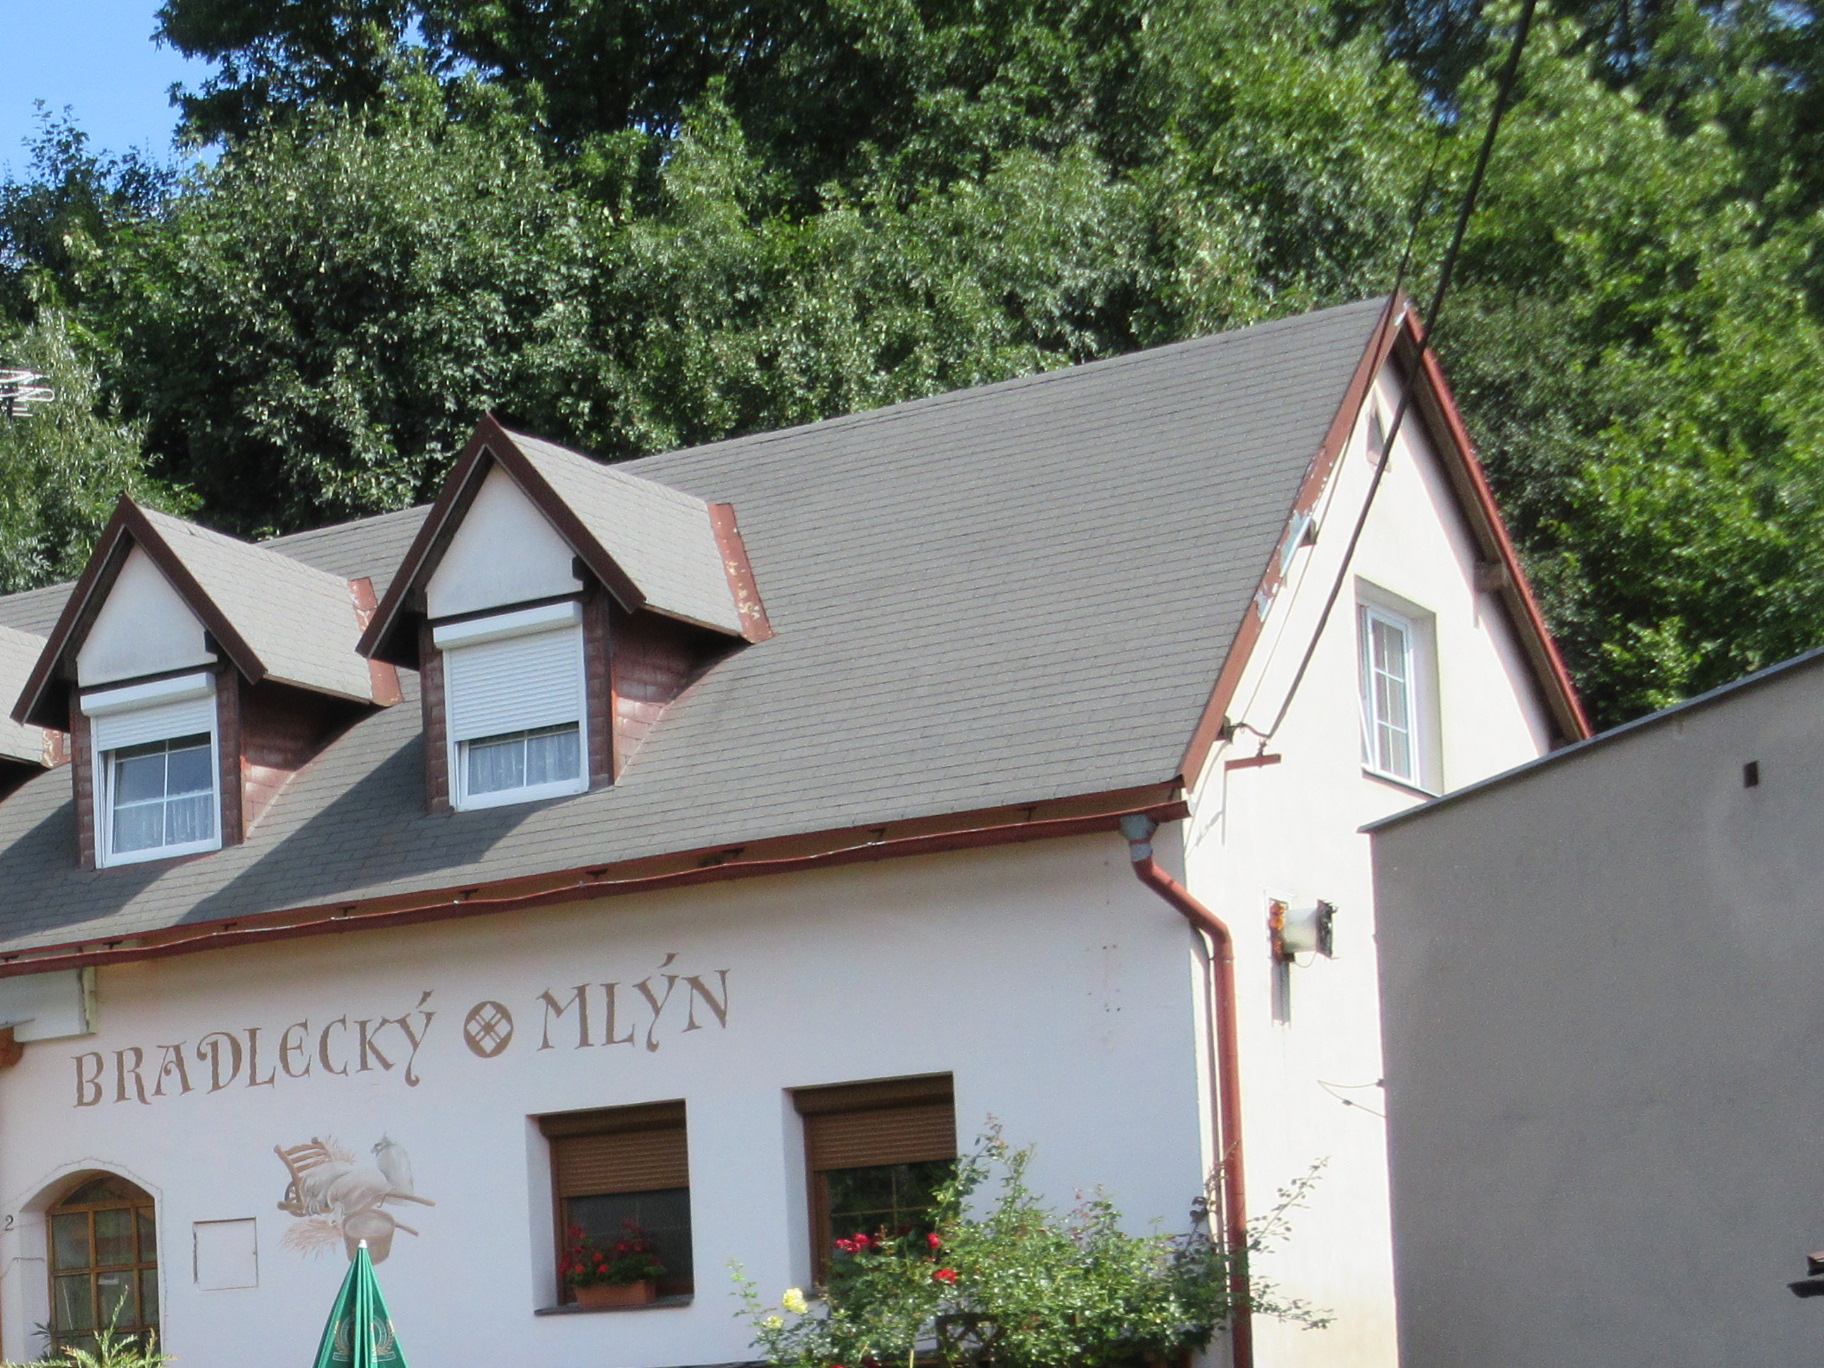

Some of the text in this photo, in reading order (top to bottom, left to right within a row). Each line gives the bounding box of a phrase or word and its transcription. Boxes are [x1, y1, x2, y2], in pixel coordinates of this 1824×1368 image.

[72, 952, 731, 1108] BRADLECKÝ MLÝN
[4, 1214, 14, 1232] 2
